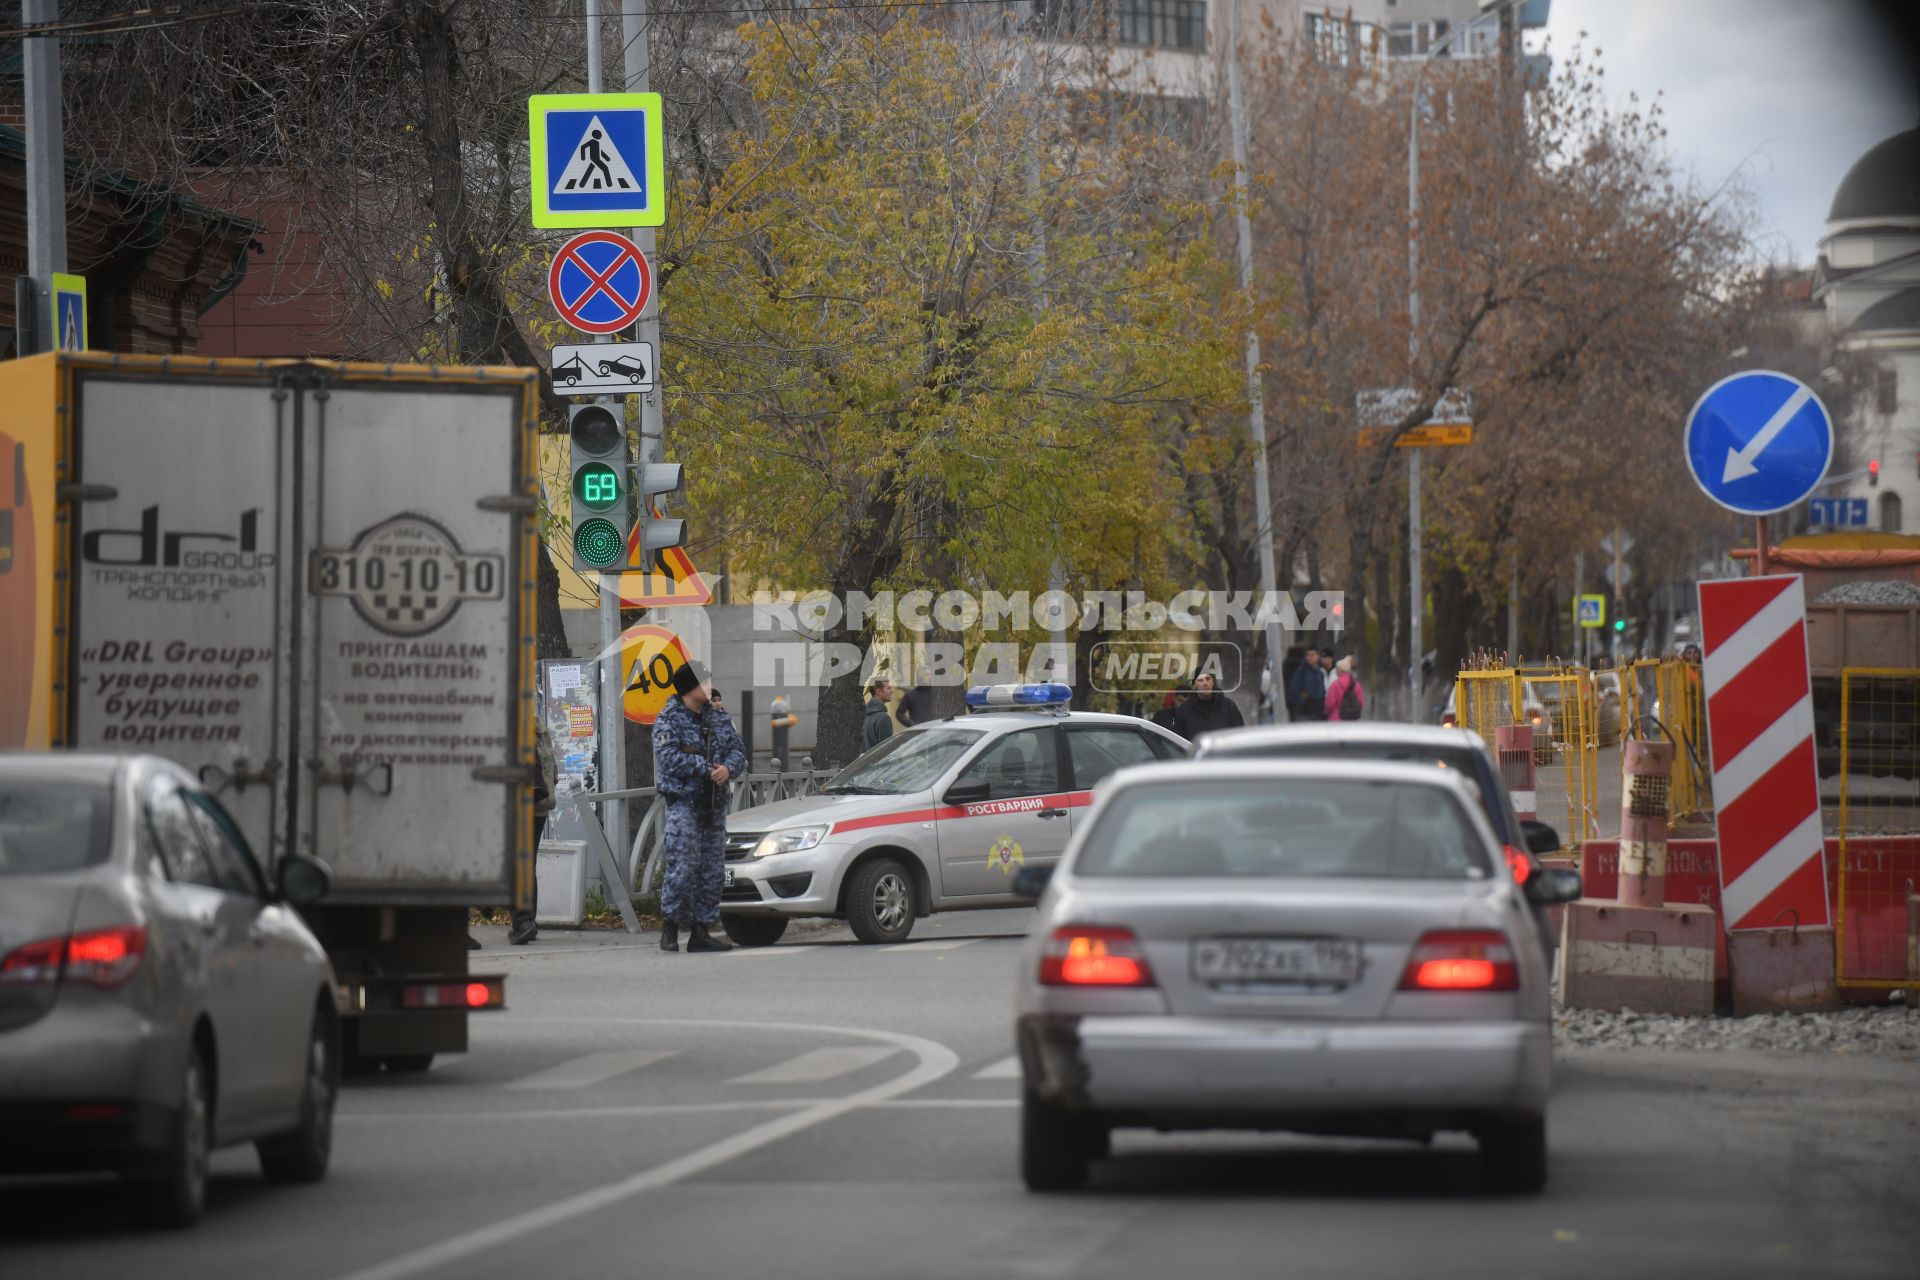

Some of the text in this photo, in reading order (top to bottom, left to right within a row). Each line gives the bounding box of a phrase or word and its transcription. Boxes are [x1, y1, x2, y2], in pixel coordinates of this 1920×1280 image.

[585, 473, 615, 501] 69
[83, 504, 258, 567] drl
[184, 551, 277, 570] GROUP
[93, 568, 267, 589] ТРАНСПОРТНЫЙ
[320, 556, 494, 594] 310-10-10
[126, 586, 230, 602] ХОЛДИНГ
[339, 642, 487, 659] ПРИГЛАШАЕМ
[96, 672, 260, 695] уверенное
[625, 653, 675, 695] 40
[104, 691, 241, 721] будущее
[343, 692, 369, 705] на
[374, 690, 496, 706] автомобили
[363, 711, 464, 724] компании
[103, 724, 242, 745] водителя
[361, 734, 507, 749] диспетчерское
[967, 799, 1044, 815] РОСГВАРДИЯ
